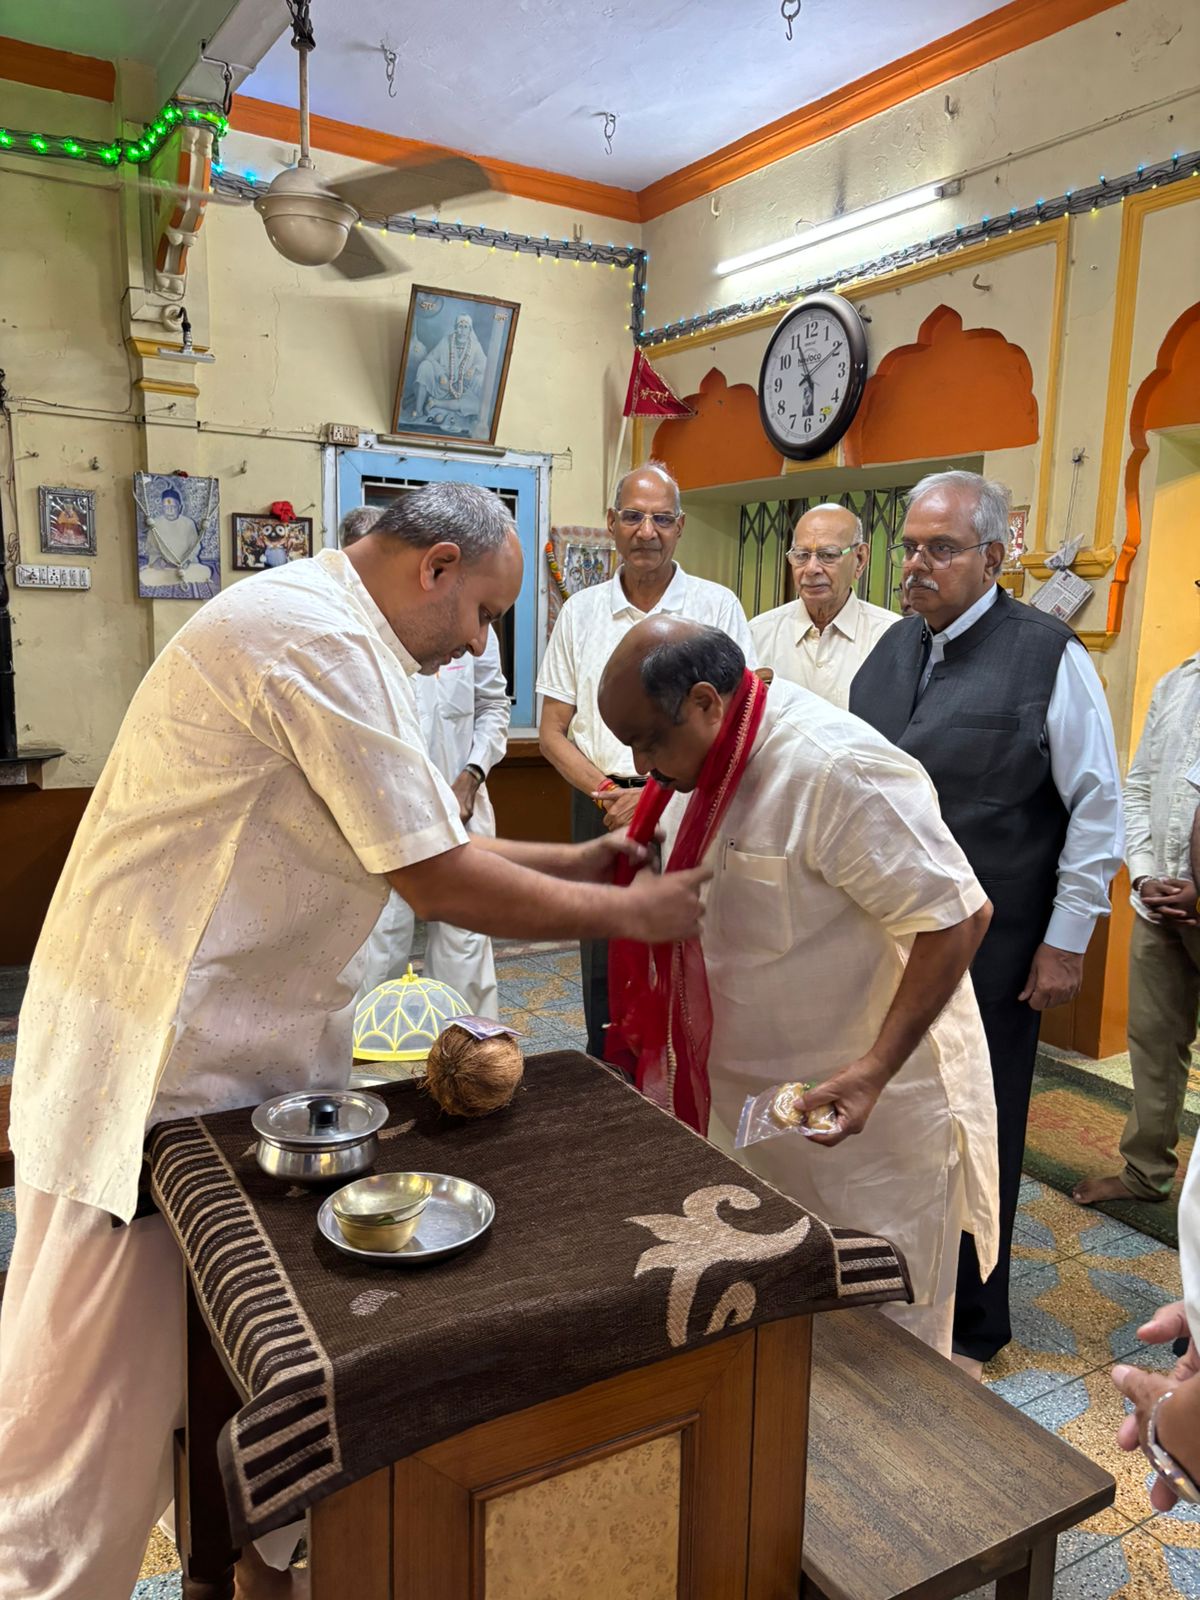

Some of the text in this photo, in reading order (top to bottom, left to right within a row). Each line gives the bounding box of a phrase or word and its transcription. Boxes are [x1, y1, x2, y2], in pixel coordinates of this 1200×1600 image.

[805, 322, 818, 339] 12
[824, 326, 829, 341] 1
[791, 334, 800, 350] 11
[832, 340, 841, 356] 2
[780, 354, 792, 371] 10
[838, 361, 846, 378] 3
[775, 378, 783, 393] 9
[831, 387, 840, 403] 4
[777, 400, 785, 415] 8
[789, 414, 797, 430] 7
[804, 417, 812, 433] 6
